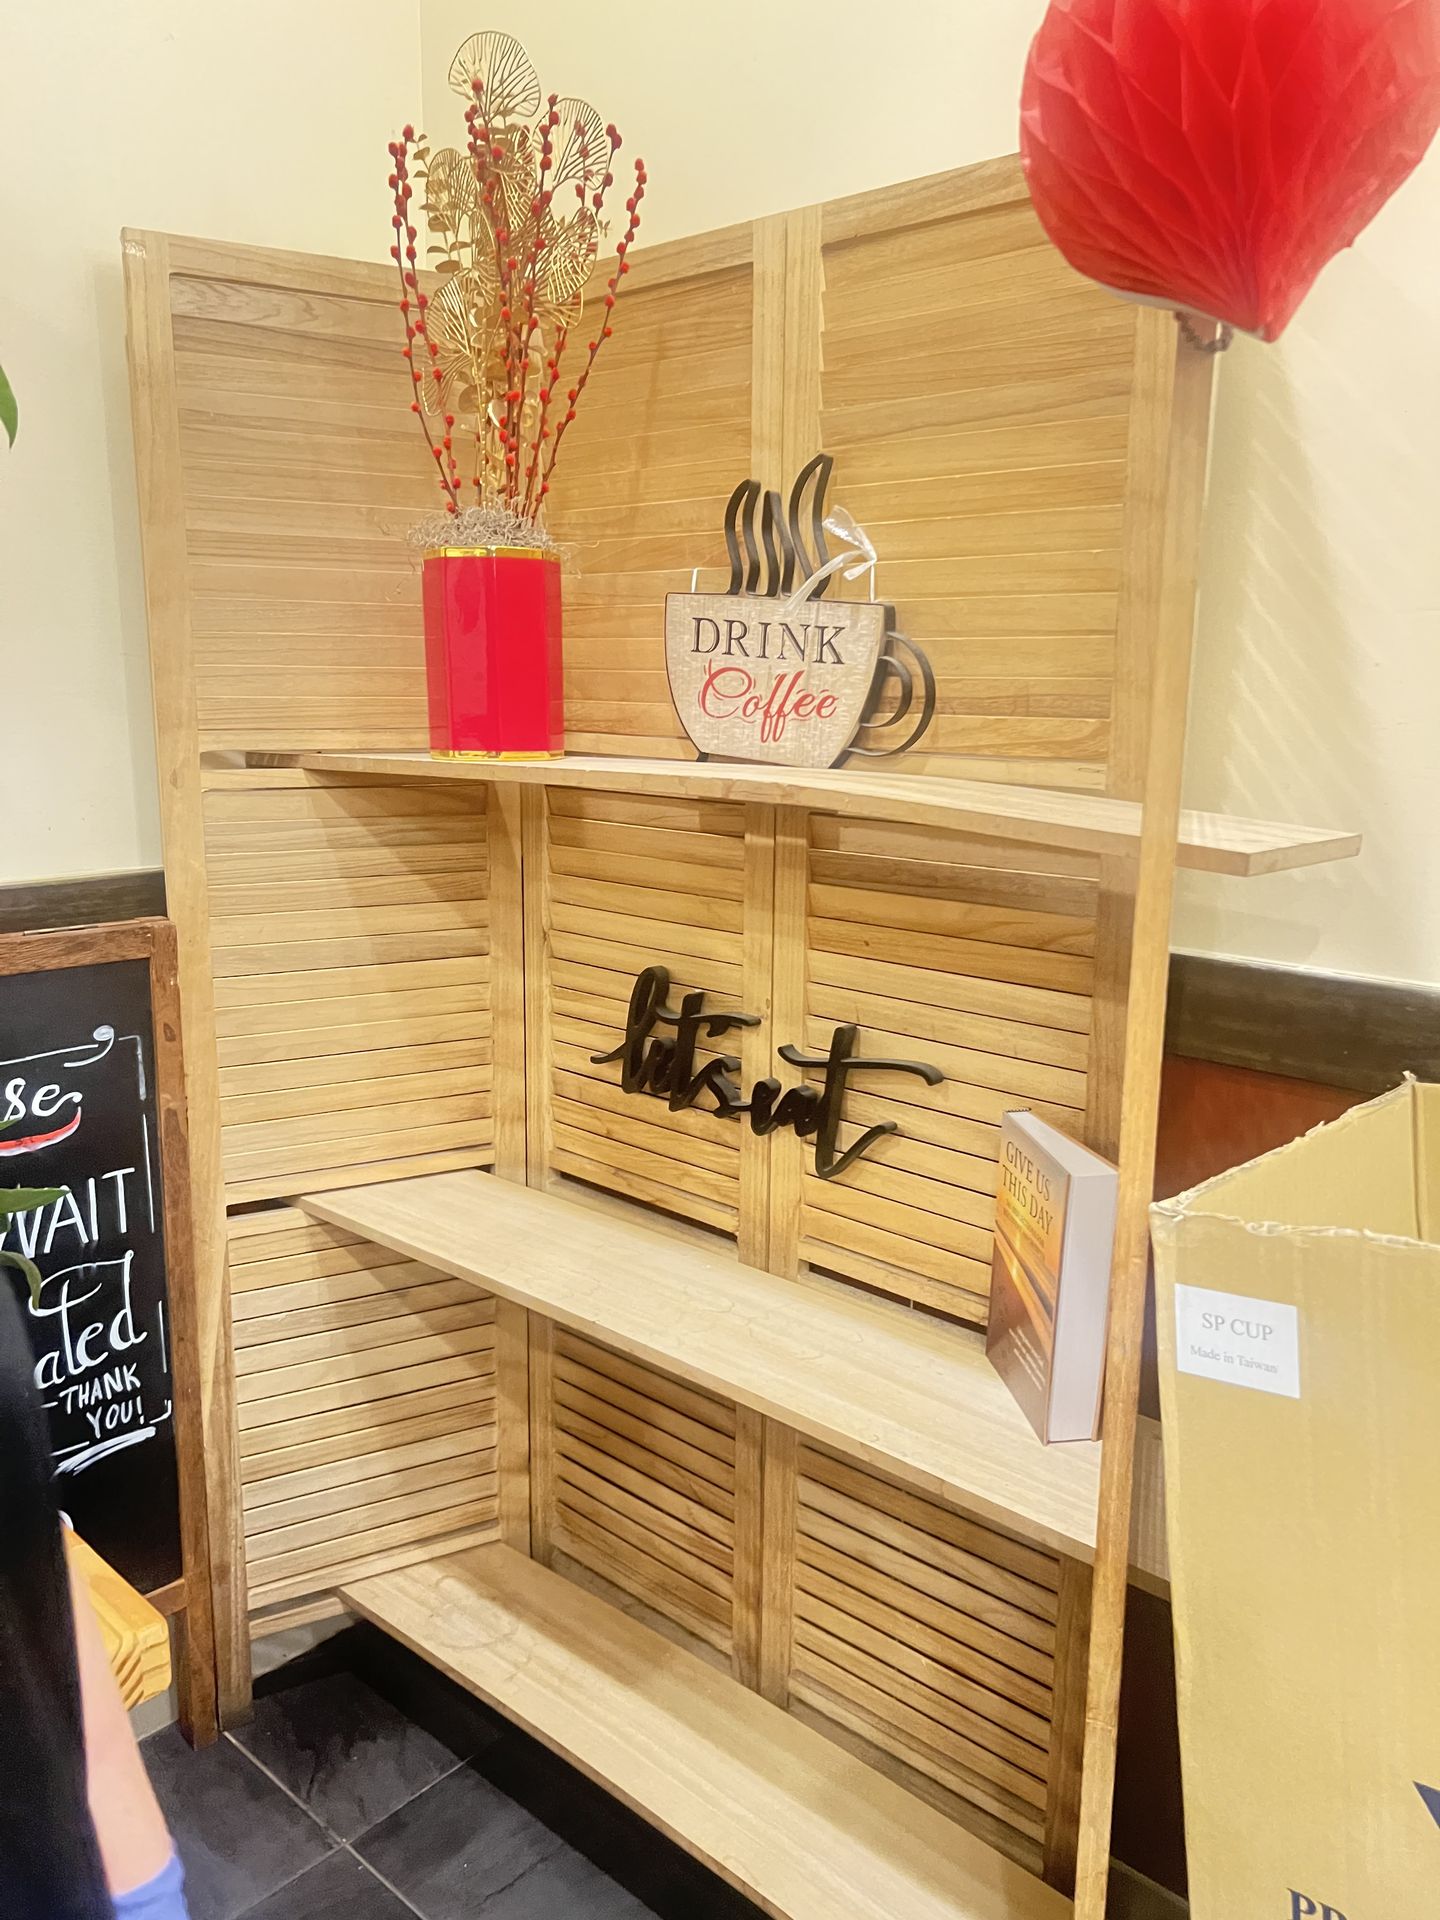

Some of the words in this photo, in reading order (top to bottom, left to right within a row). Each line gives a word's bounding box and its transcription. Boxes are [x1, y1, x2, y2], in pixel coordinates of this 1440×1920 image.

[690, 617, 846, 665] DRINK
[698, 658, 840, 744] Coffee
[1005, 1141, 1034, 1184] GIVE
[1036, 1169, 1050, 1202] US
[1002, 1164, 1028, 1208] THIS
[1029, 1193, 1053, 1236] DAY
[1201, 1312, 1225, 1331] SP
[1230, 1319, 1273, 1341] CUP
[1190, 1345, 1221, 1361] Made
[1223, 1351, 1235, 1364] in
[1236, 1355, 1278, 1374] Taiwan
[59, 1362, 142, 1415] THANK
[86, 1395, 145, 1440] YOU!
